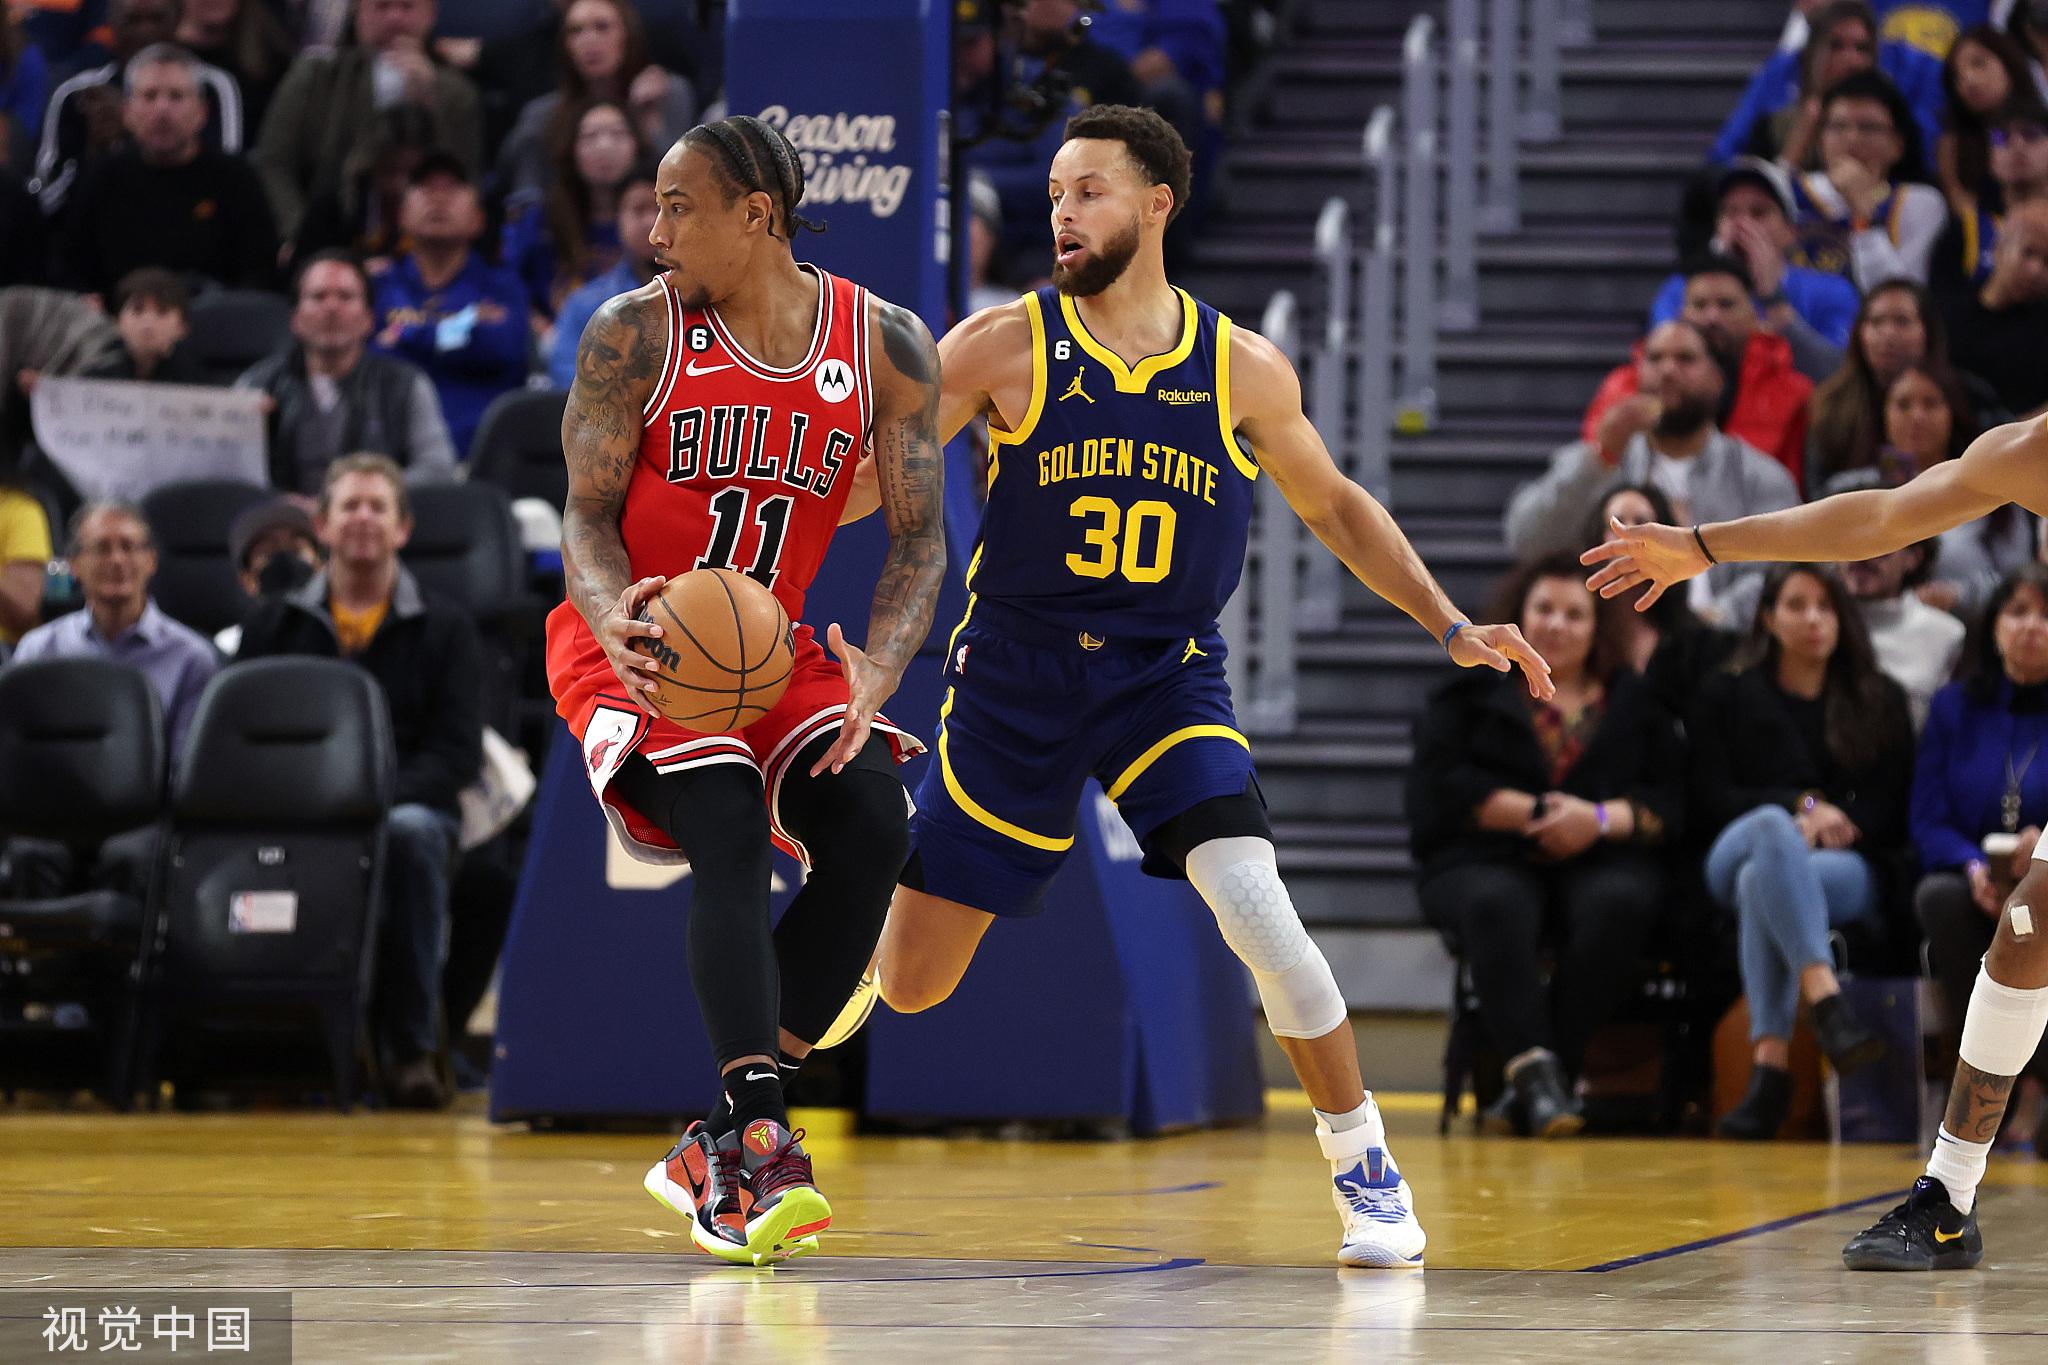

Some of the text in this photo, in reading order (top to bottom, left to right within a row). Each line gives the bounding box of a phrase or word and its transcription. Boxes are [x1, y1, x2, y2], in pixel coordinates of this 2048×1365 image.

[691, 328, 708, 350] 6
[1054, 340, 1071, 360] 6
[1157, 388, 1211, 404] Rakuten
[666, 405, 855, 499] BULLS
[1038, 437, 1219, 506] GOLDEN STATE
[693, 485, 795, 592] 11
[1065, 495, 1177, 584] 30
